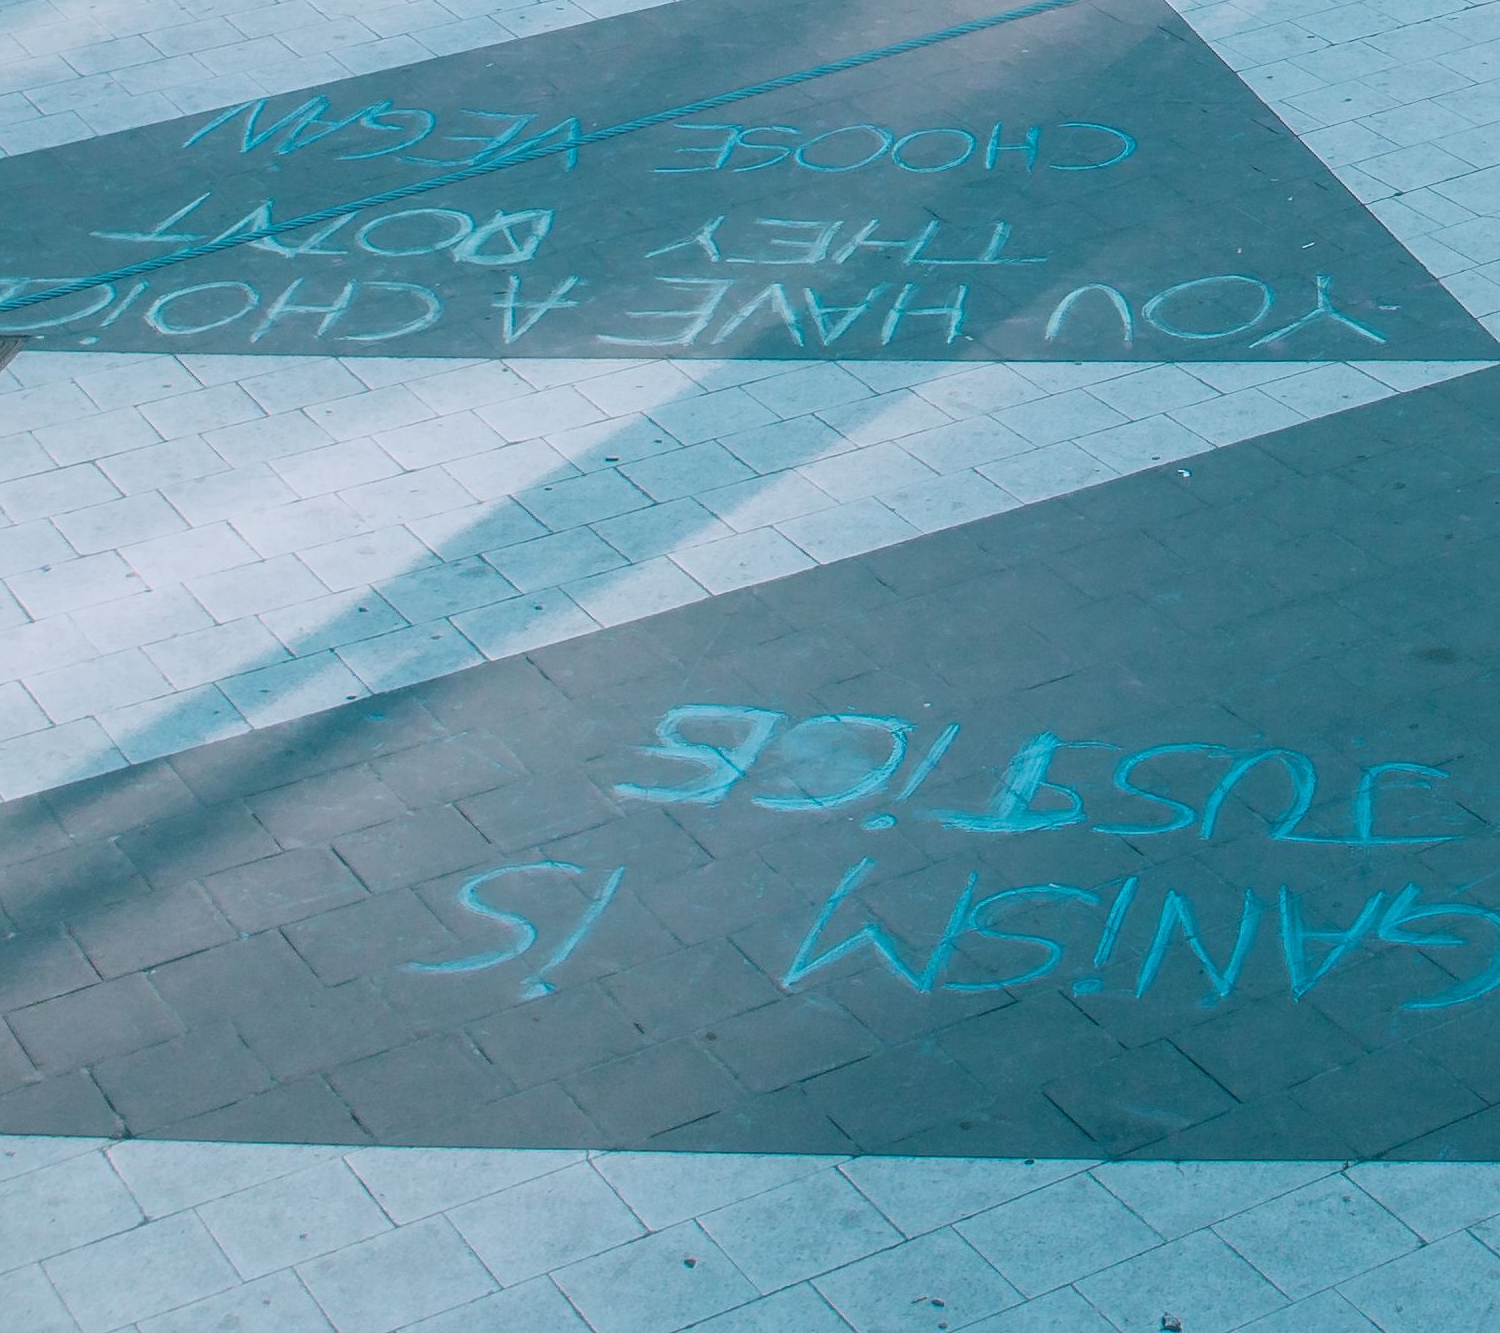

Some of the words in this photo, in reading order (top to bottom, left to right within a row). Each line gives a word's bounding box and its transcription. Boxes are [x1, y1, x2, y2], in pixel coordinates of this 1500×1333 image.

[178, 95, 580, 172] VEGAN
[649, 121, 1136, 173] CHOOSE
[643, 215, 1045, 266] THEY
[490, 275, 580, 344] A
[596, 276, 967, 348] HAVE
[1043, 276, 1386, 347] YOU
[405, 858, 627, 1000] IS
